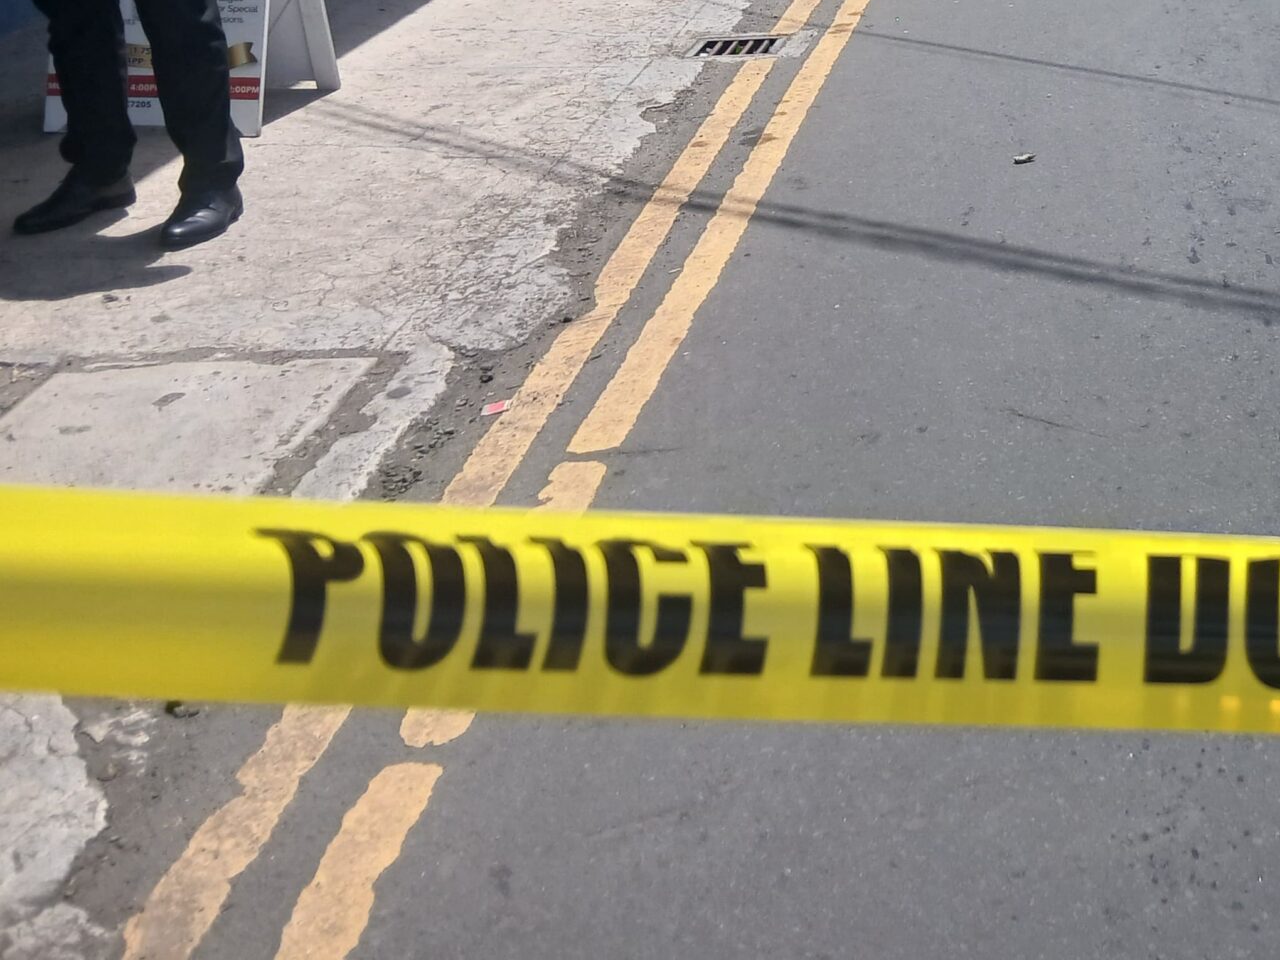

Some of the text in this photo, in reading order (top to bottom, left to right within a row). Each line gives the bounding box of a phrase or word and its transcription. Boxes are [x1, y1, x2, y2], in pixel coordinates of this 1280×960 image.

[227, 5, 258, 13] Special
[250, 527, 769, 677] POLICE
[804, 543, 1100, 683] LINE
